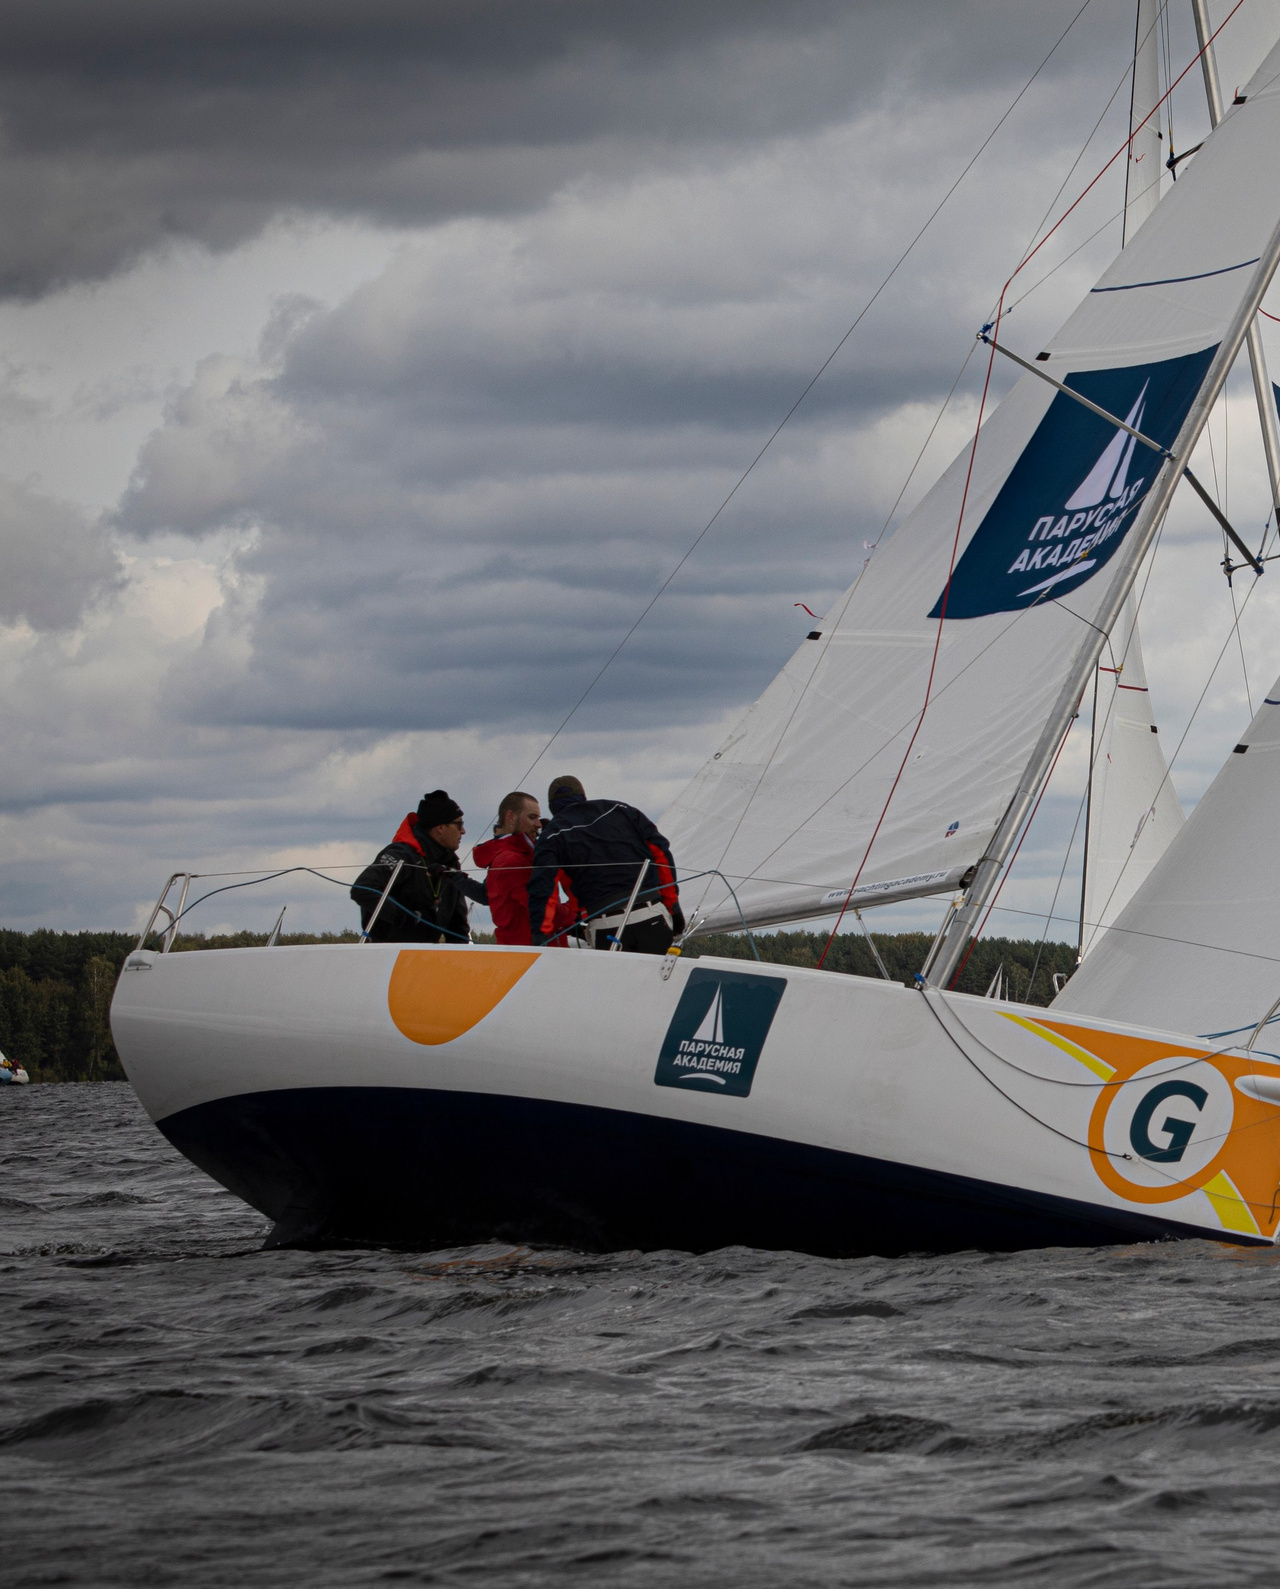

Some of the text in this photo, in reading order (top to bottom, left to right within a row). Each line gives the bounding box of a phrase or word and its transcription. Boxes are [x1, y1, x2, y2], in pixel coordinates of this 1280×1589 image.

[827, 871, 948, 899] wwwyachtingacademy.ru
[678, 1040, 745, 1060] ПАРУСНАЯ
[672, 1053, 742, 1074] АКАДЕМИЯ
[1129, 1079, 1209, 1164] G
